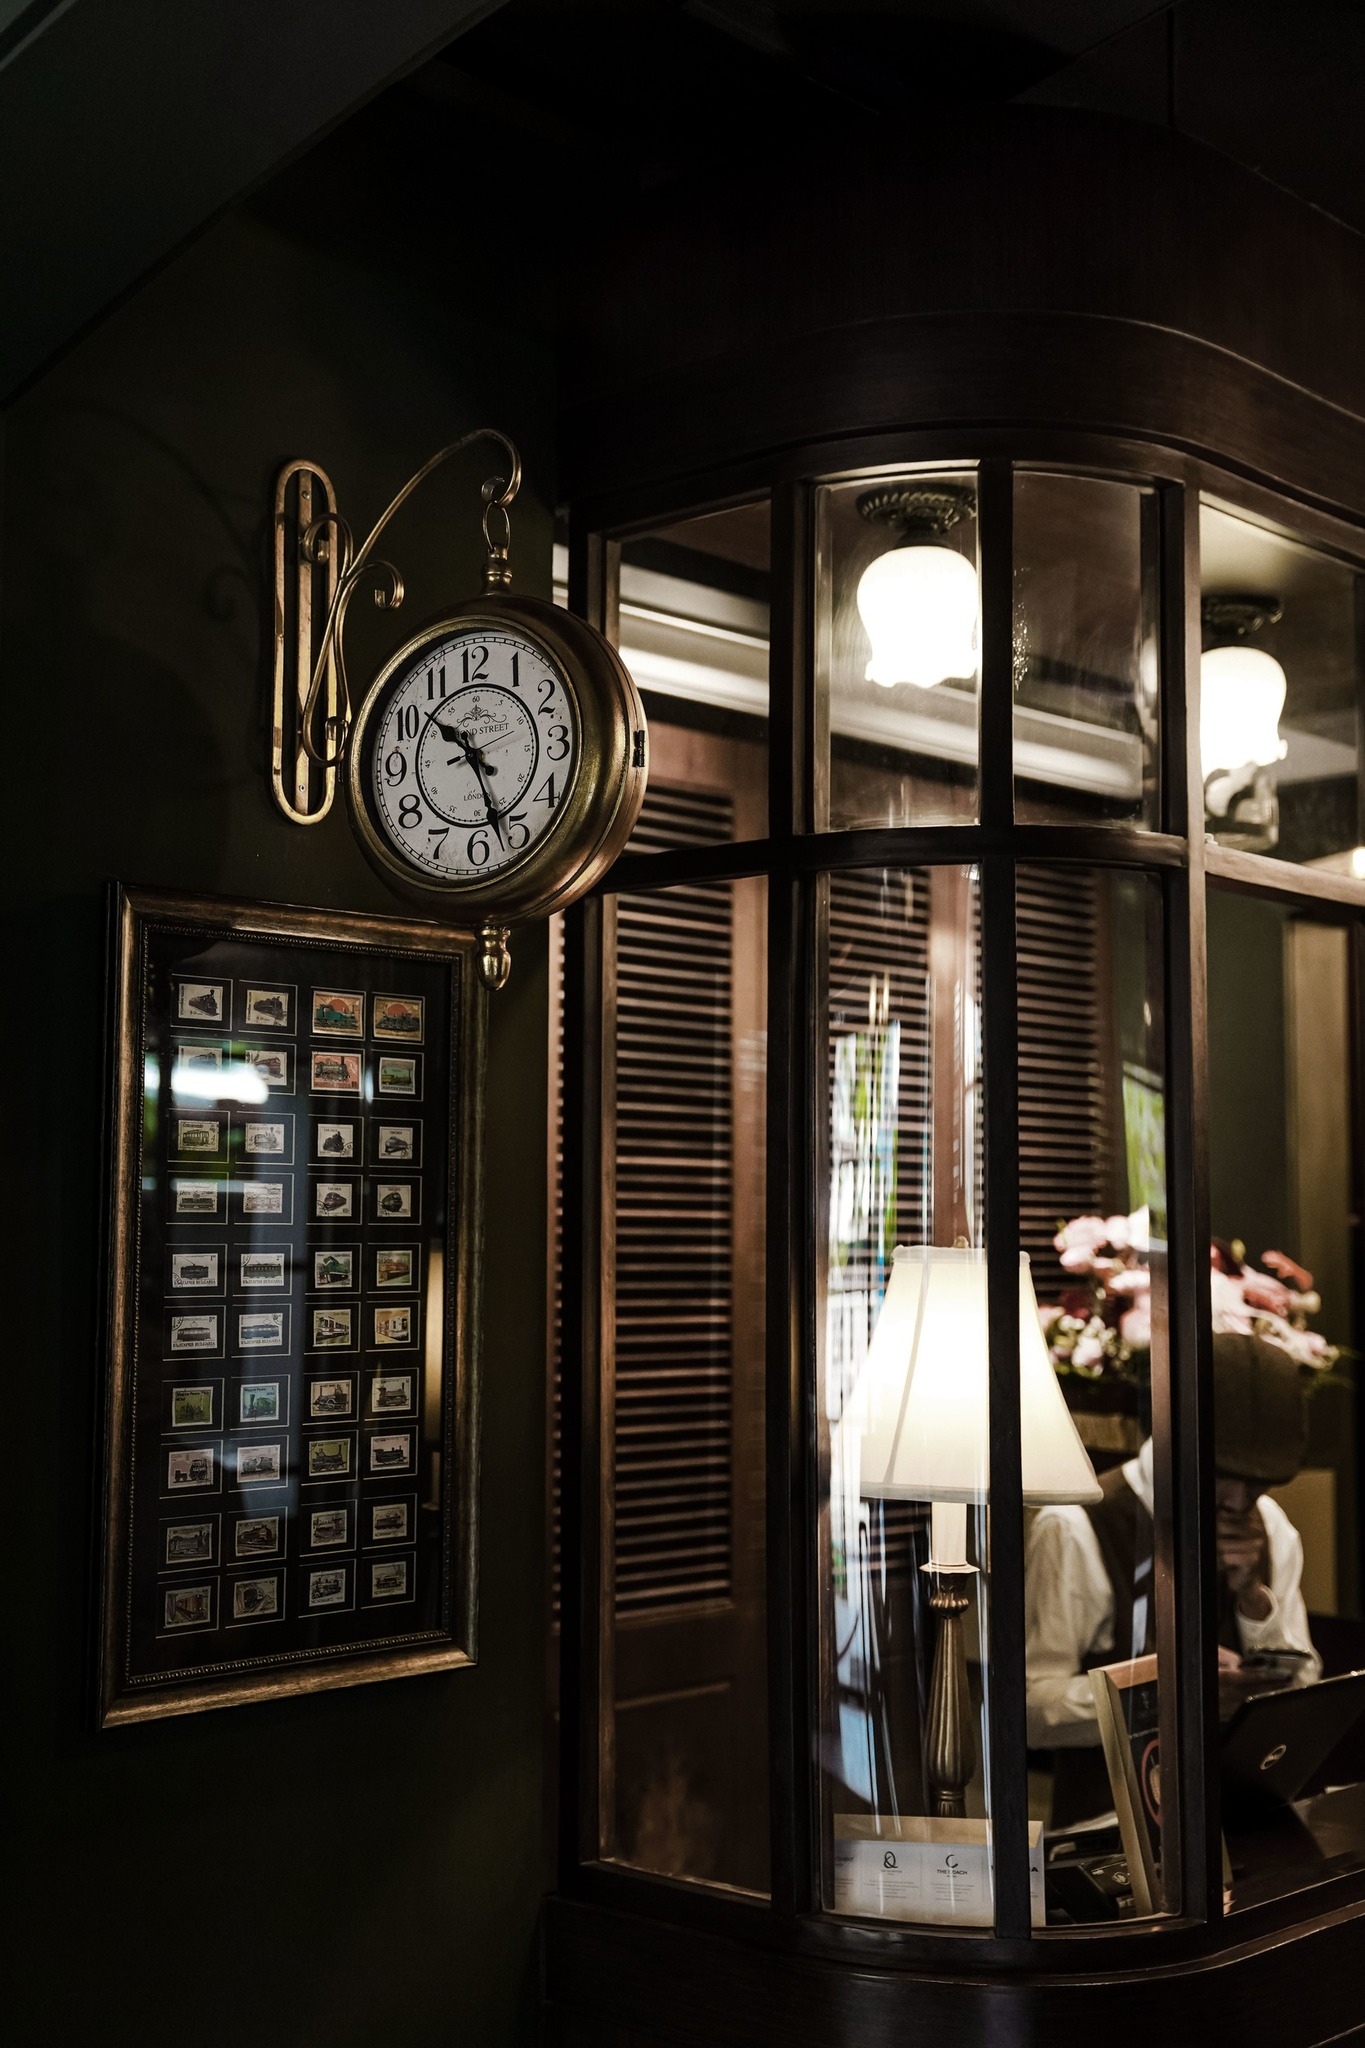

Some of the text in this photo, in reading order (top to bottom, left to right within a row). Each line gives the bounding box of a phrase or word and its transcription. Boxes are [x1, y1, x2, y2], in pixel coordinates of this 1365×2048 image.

[461, 646, 489, 683] 12
[510, 651, 520, 687] 1
[426, 665, 447, 700] 11
[537, 679, 556, 716] 2
[396, 704, 419, 742] 10
[448, 706, 455, 715] 55
[516, 716, 524, 725] 10
[431, 730, 437, 739] 50
[479, 722, 509, 734] STREET
[546, 724, 570, 761] 3
[425, 759, 431, 768] 45
[524, 744, 530, 753] 15
[385, 751, 407, 786] 9
[517, 773, 525, 783] 20
[431, 786, 438, 795] 40
[463, 793, 490, 801] LONDO
[532, 771, 561, 809] 4
[398, 794, 423, 829] 8
[449, 805, 457, 813] 35
[474, 809, 481, 817] 30
[428, 827, 450, 860] 7
[508, 812, 530, 849] 5
[467, 829, 490, 866] 6
